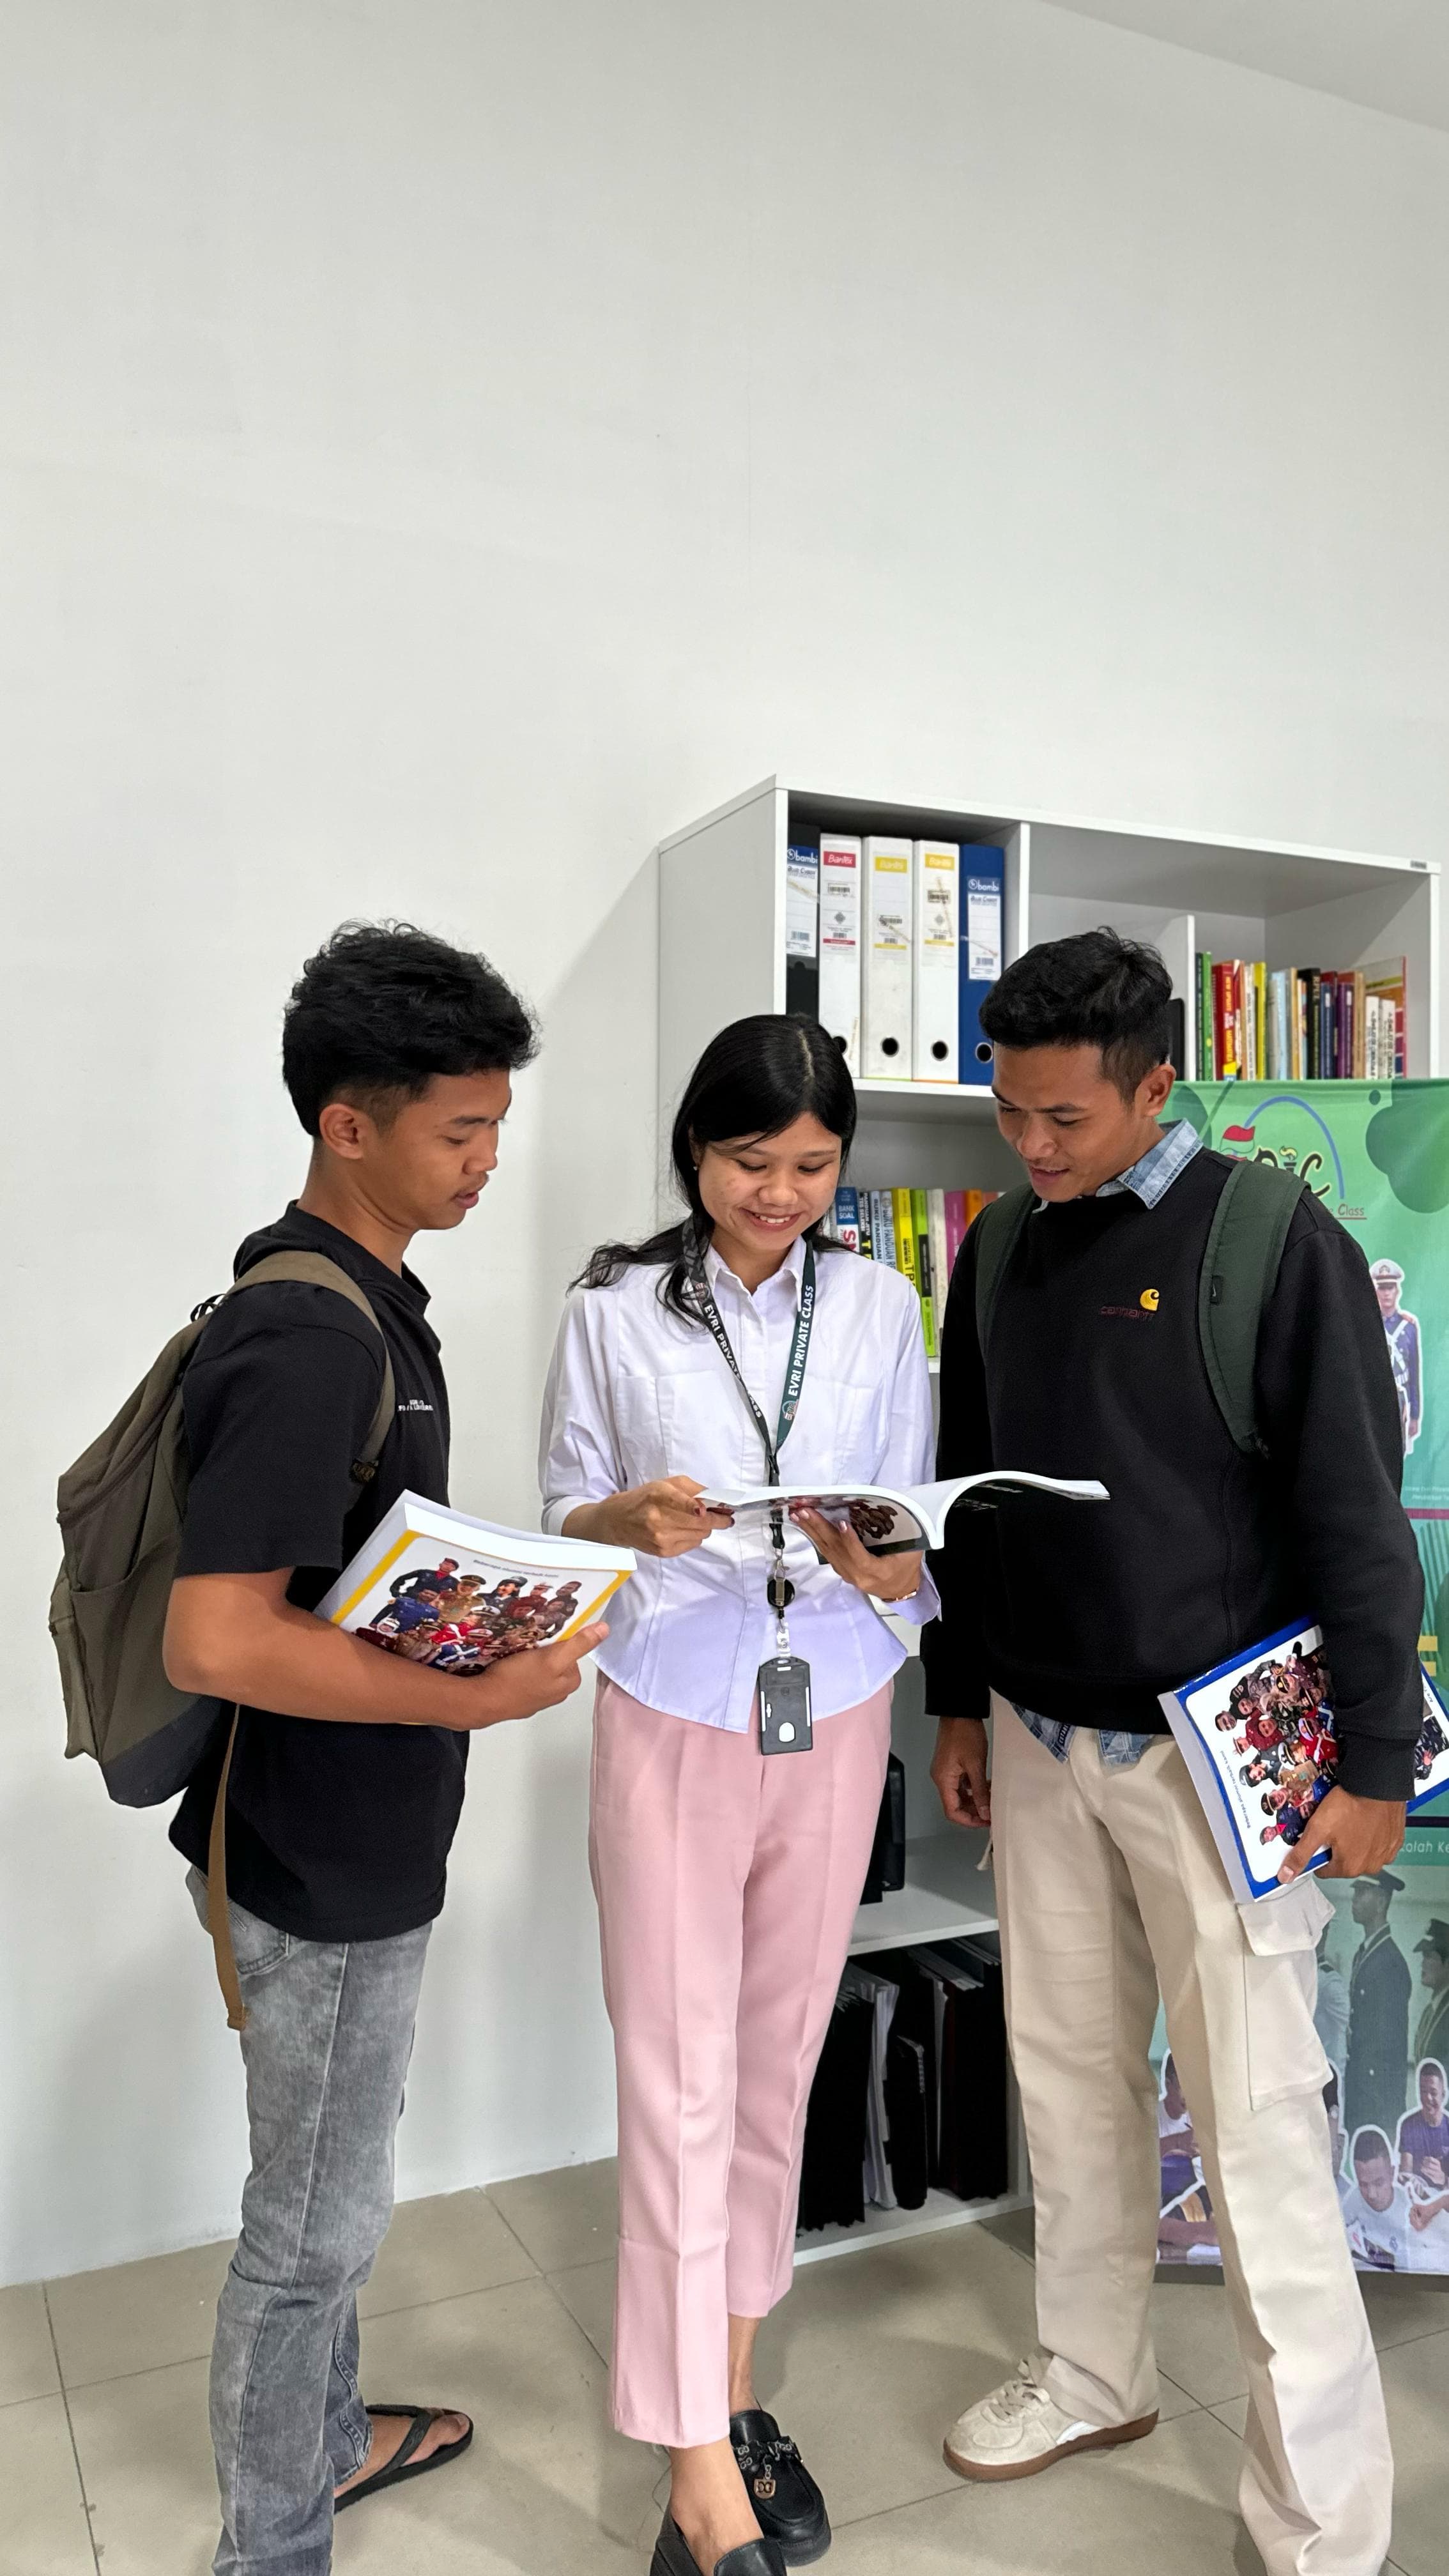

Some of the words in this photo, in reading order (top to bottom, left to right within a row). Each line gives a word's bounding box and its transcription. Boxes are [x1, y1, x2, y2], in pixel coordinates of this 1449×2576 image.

[795, 850, 818, 864] bambi
[828, 854, 853, 864] Bantex
[977, 880, 999, 891] bambi
[883, 1209, 893, 1227] BUKU
[1337, 1204, 1365, 1216] Class
[884, 1229, 895, 1259] PANDUAN
[801, 1285, 814, 1319] CLASS
[704, 1304, 721, 1331] EVRI
[793, 1321, 809, 1367] PRIVATE
[788, 1370, 802, 1397] EVRI
